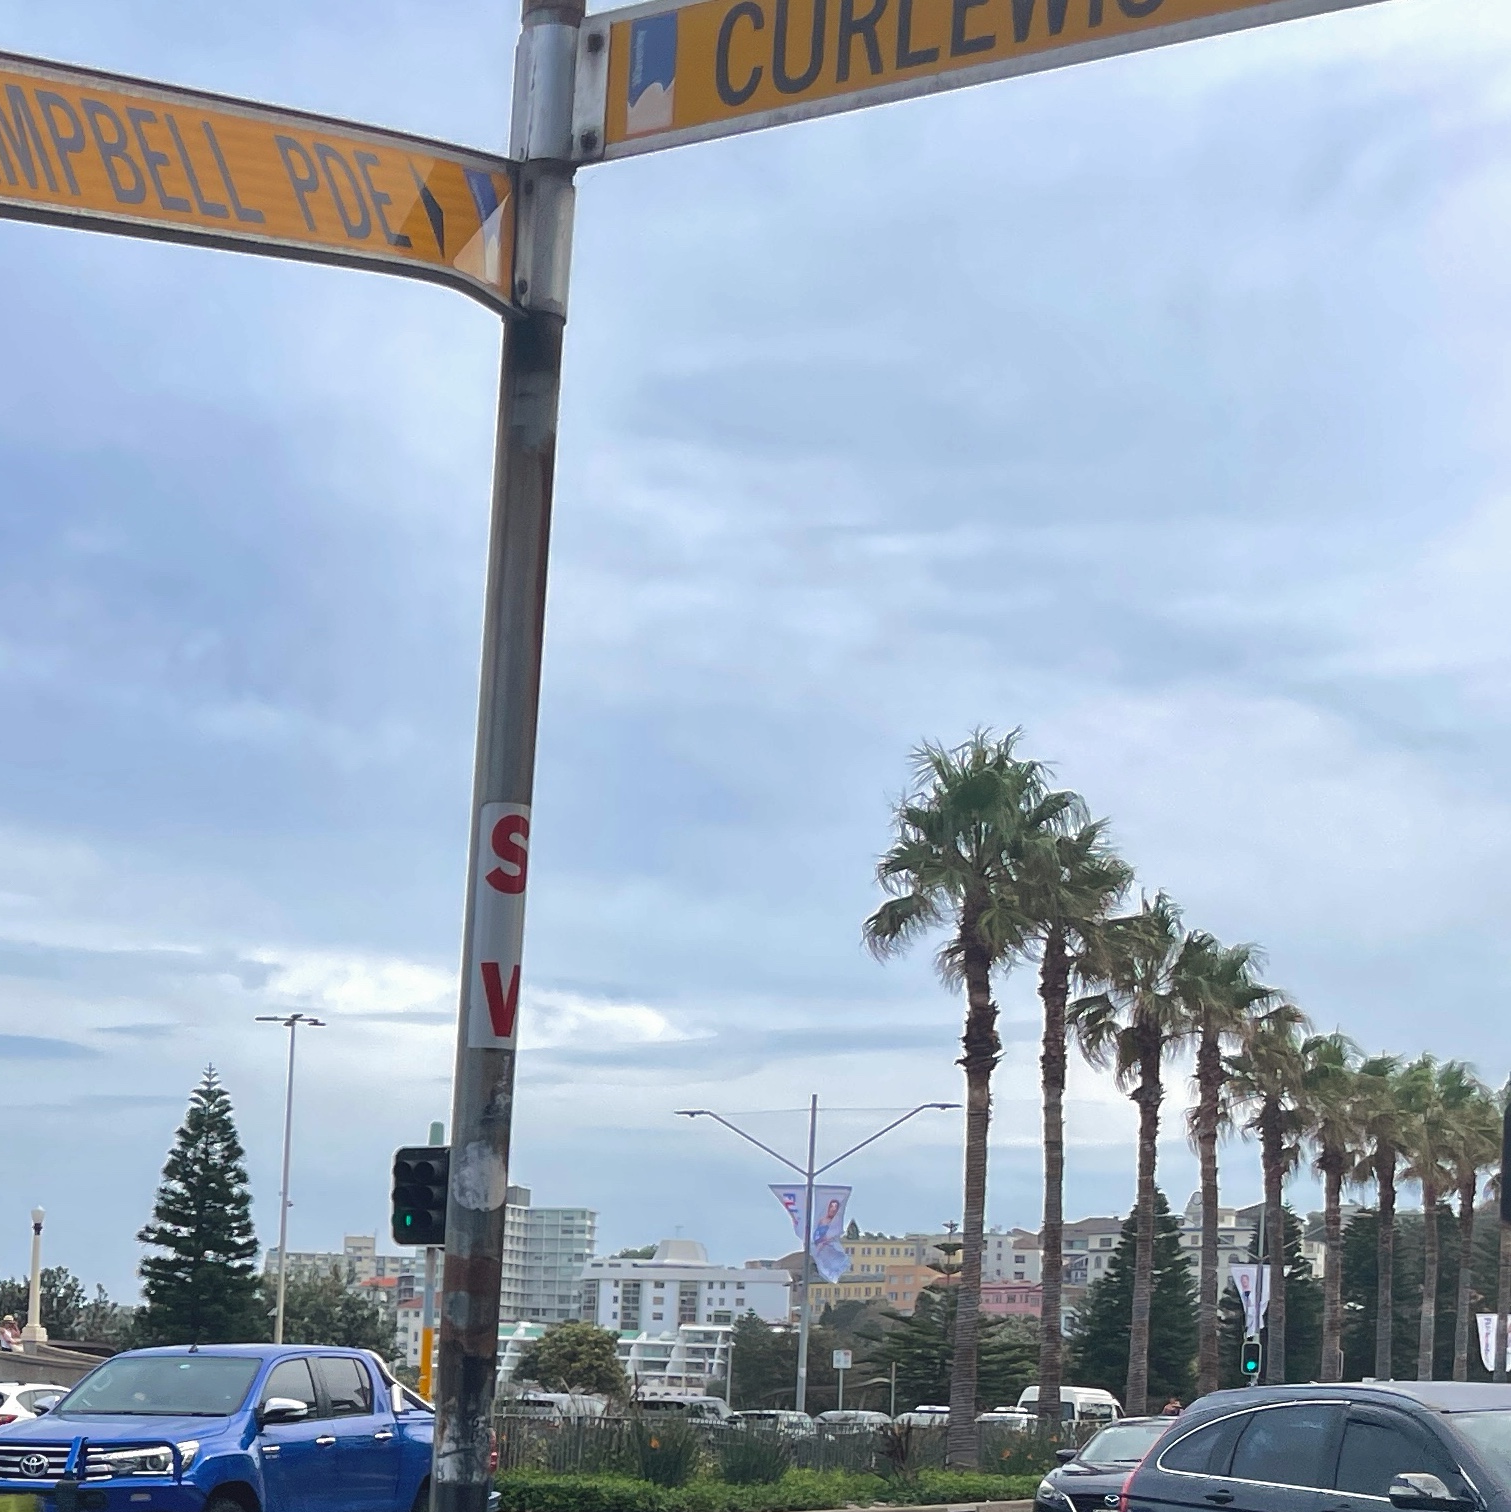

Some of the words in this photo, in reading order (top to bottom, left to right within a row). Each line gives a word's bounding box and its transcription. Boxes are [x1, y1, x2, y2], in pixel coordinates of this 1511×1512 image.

[715, 0, 1156, 106] CURLE
[279, 133, 413, 249] PDE
[486, 814, 529, 894] S
[481, 962, 521, 1038] V
